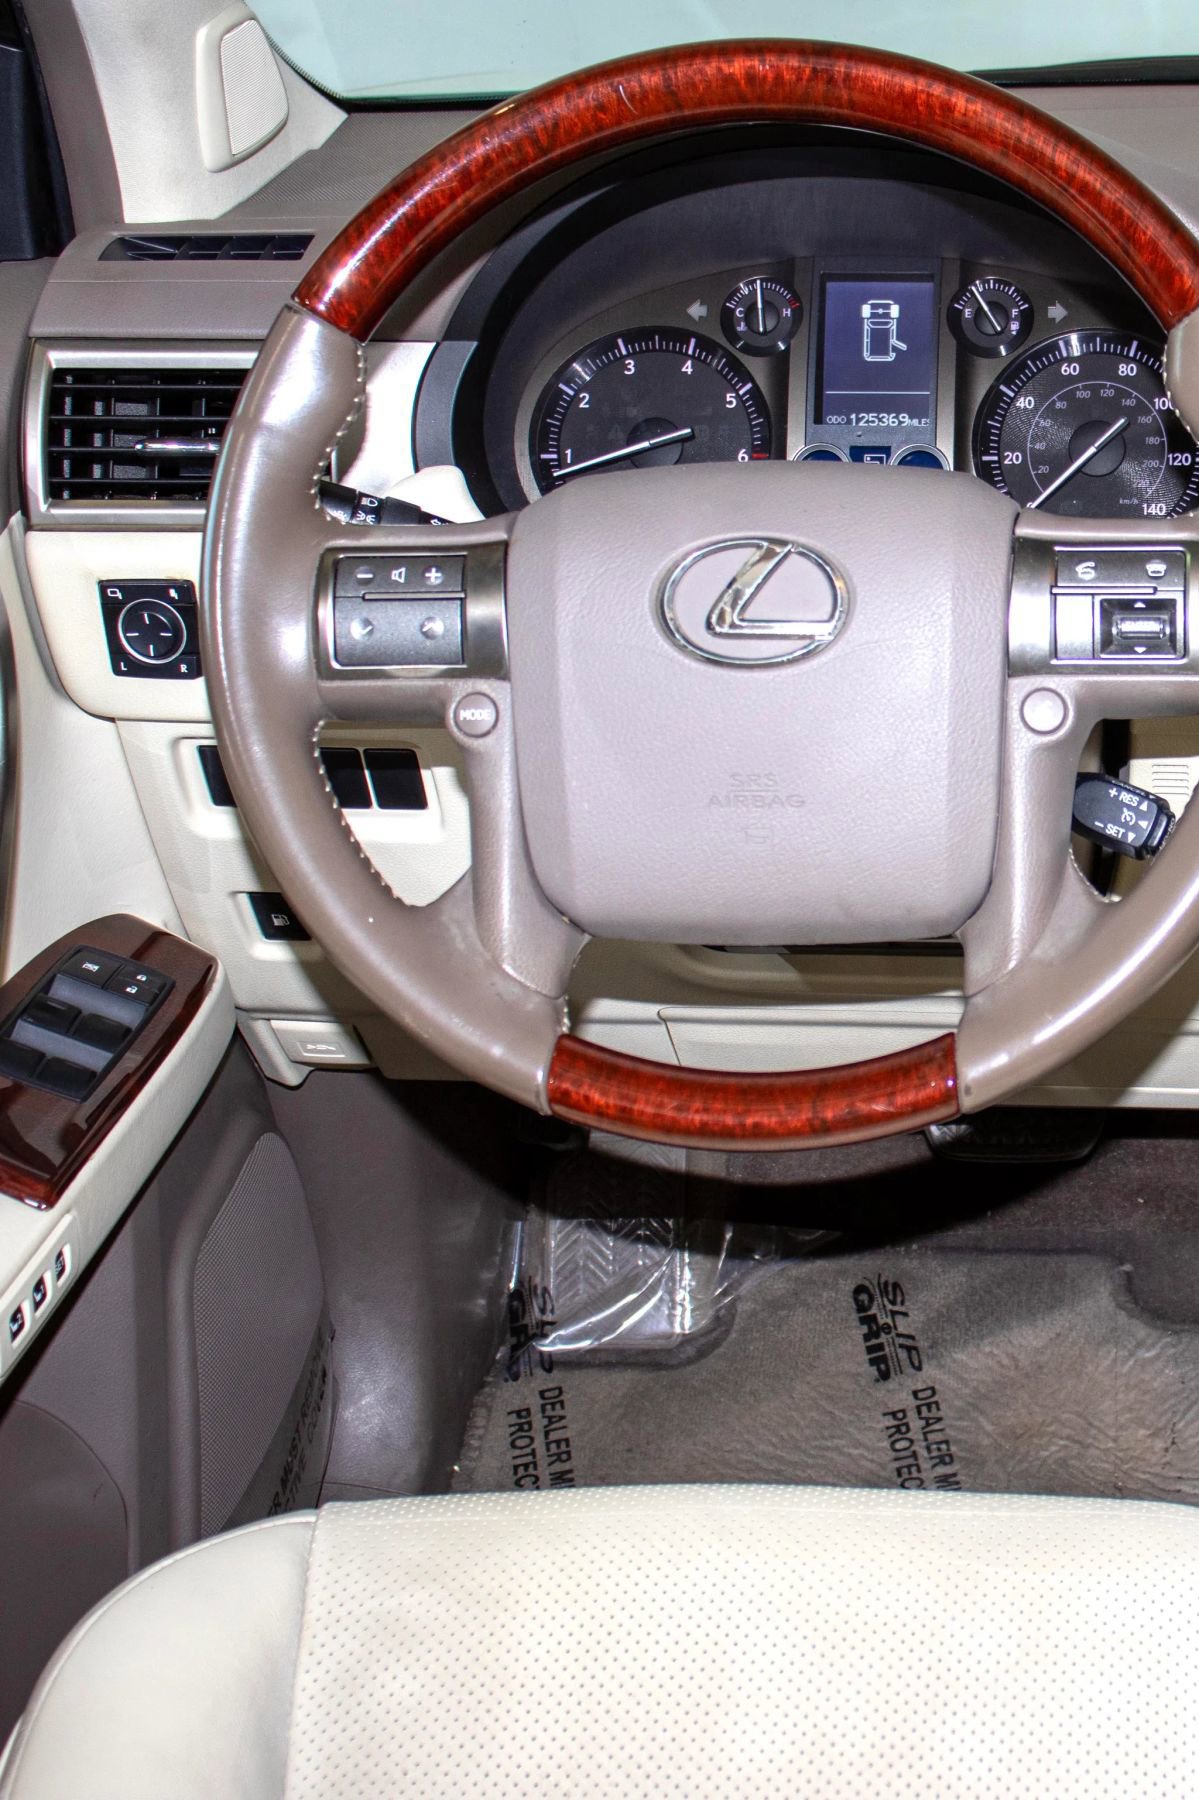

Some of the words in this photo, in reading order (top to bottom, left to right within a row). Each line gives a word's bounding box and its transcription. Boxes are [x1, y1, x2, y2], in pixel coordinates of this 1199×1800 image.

[736, 308, 744, 318] C
[782, 308, 791, 318] H
[965, 308, 972, 318] E
[1012, 309, 1018, 318] F
[624, 361, 635, 374] 3
[681, 360, 693, 374] 4
[1061, 363, 1080, 376] 60
[1118, 364, 1137, 376] 80
[1075, 390, 1091, 398] 100
[1100, 388, 1115, 397] 120
[579, 394, 589, 408] 2
[726, 394, 736, 408] 5
[1016, 397, 1034, 409] 40
[1055, 401, 1067, 409] 80
[1121, 398, 1136, 406] 140
[826, 415, 847, 424] ODO
[850, 413, 909, 426] 125369
[1137, 416, 1152, 424] 160
[1034, 442, 1046, 450] 40
[1145, 437, 1160, 445] 180
[565, 450, 572, 464] 1
[738, 450, 749, 462] 6
[1004, 452, 1022, 465] 20
[1168, 453, 1191, 466] 120
[1038, 465, 1049, 473] 20
[1142, 504, 1166, 516] 140
[120, 661, 128, 671] L
[180, 664, 189, 673] R
[729, 773, 778, 788] SRS
[708, 794, 805, 808] AIRBAG
[1119, 791, 1139, 807] RES
[1105, 823, 1126, 839] SET
[883, 1279, 923, 1372] SLIP
[853, 1284, 891, 1382] GRIP
[539, 1386, 573, 1467] DEALER
[912, 1386, 955, 1469] DEALER
[507, 1407, 541, 1490] PROTEC
[882, 1409, 926, 1490] PROTEC
